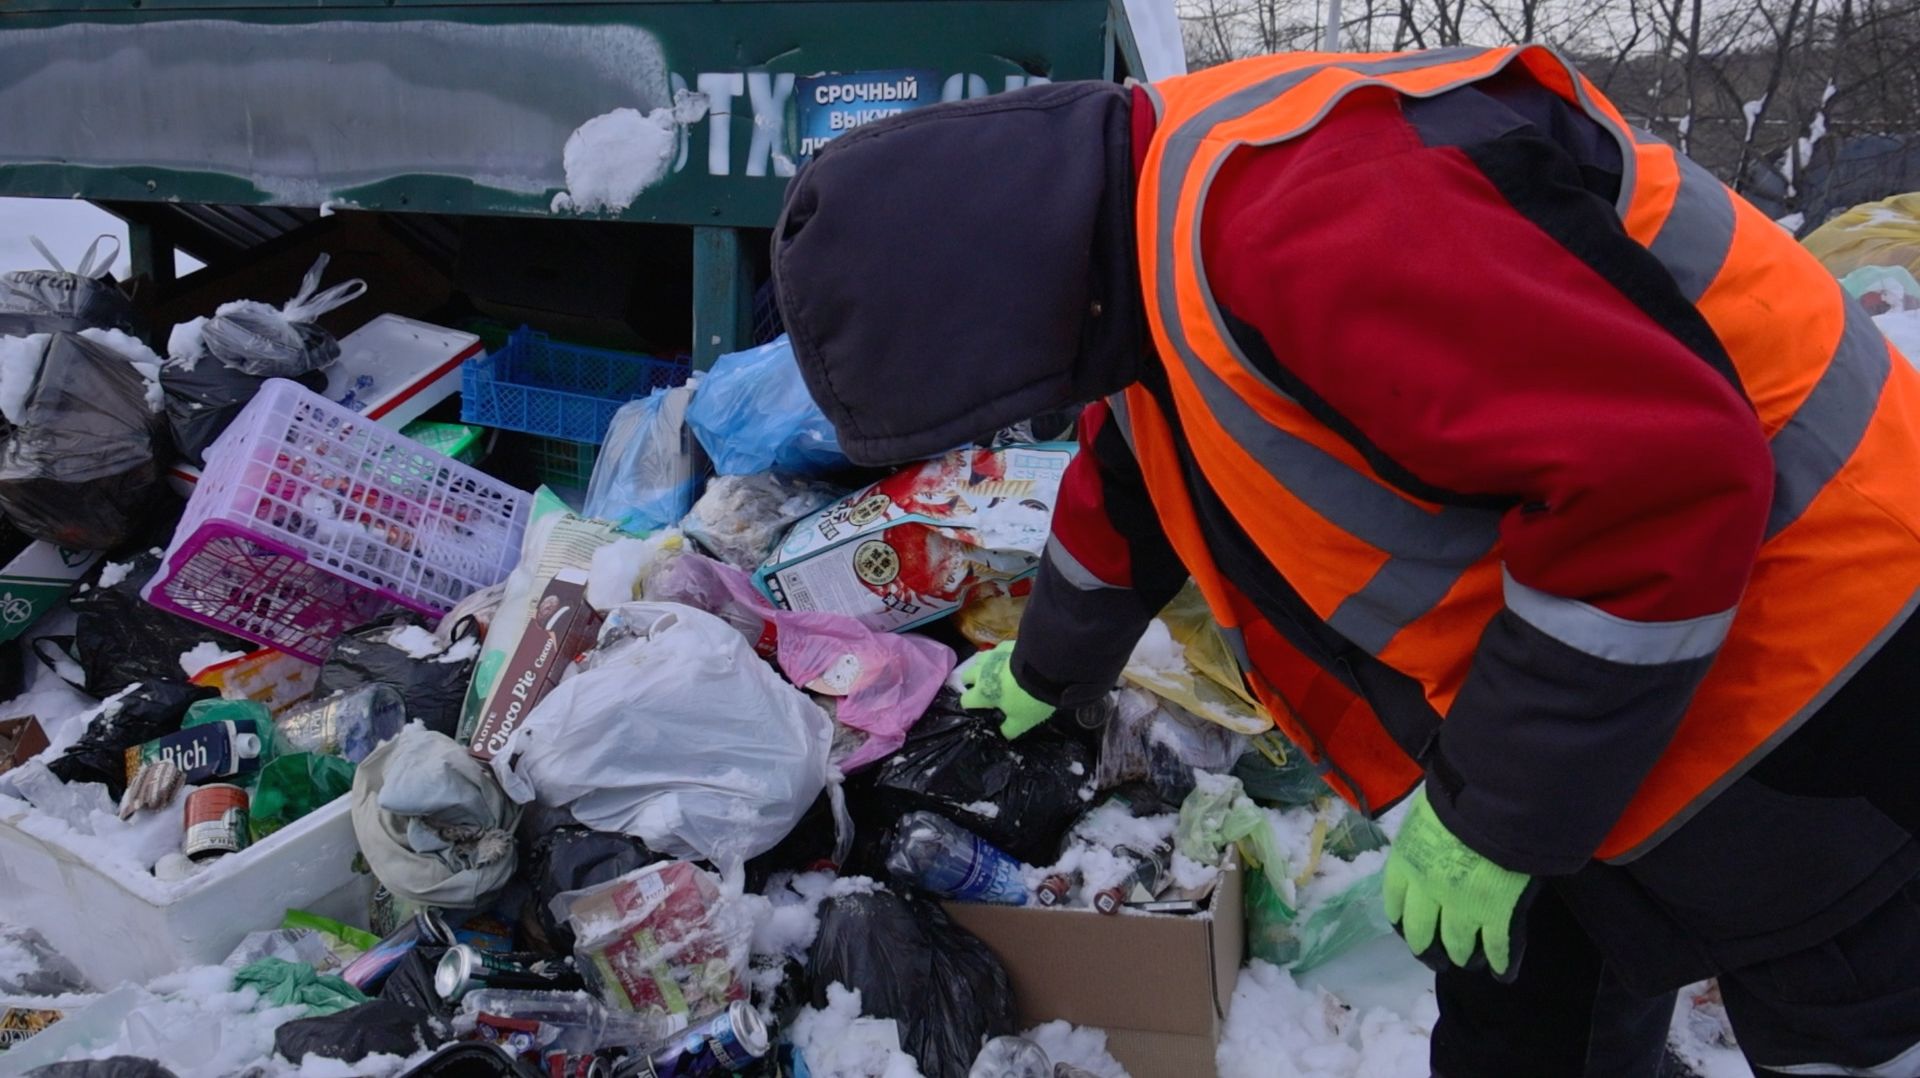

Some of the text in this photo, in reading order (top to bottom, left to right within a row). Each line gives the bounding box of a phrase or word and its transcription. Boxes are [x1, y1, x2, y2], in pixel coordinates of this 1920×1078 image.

[815, 76, 918, 104] СРОЧНЫЙ
[487, 638, 554, 755] Choco Pie Cacao
[479, 711, 498, 742] LOTTE
